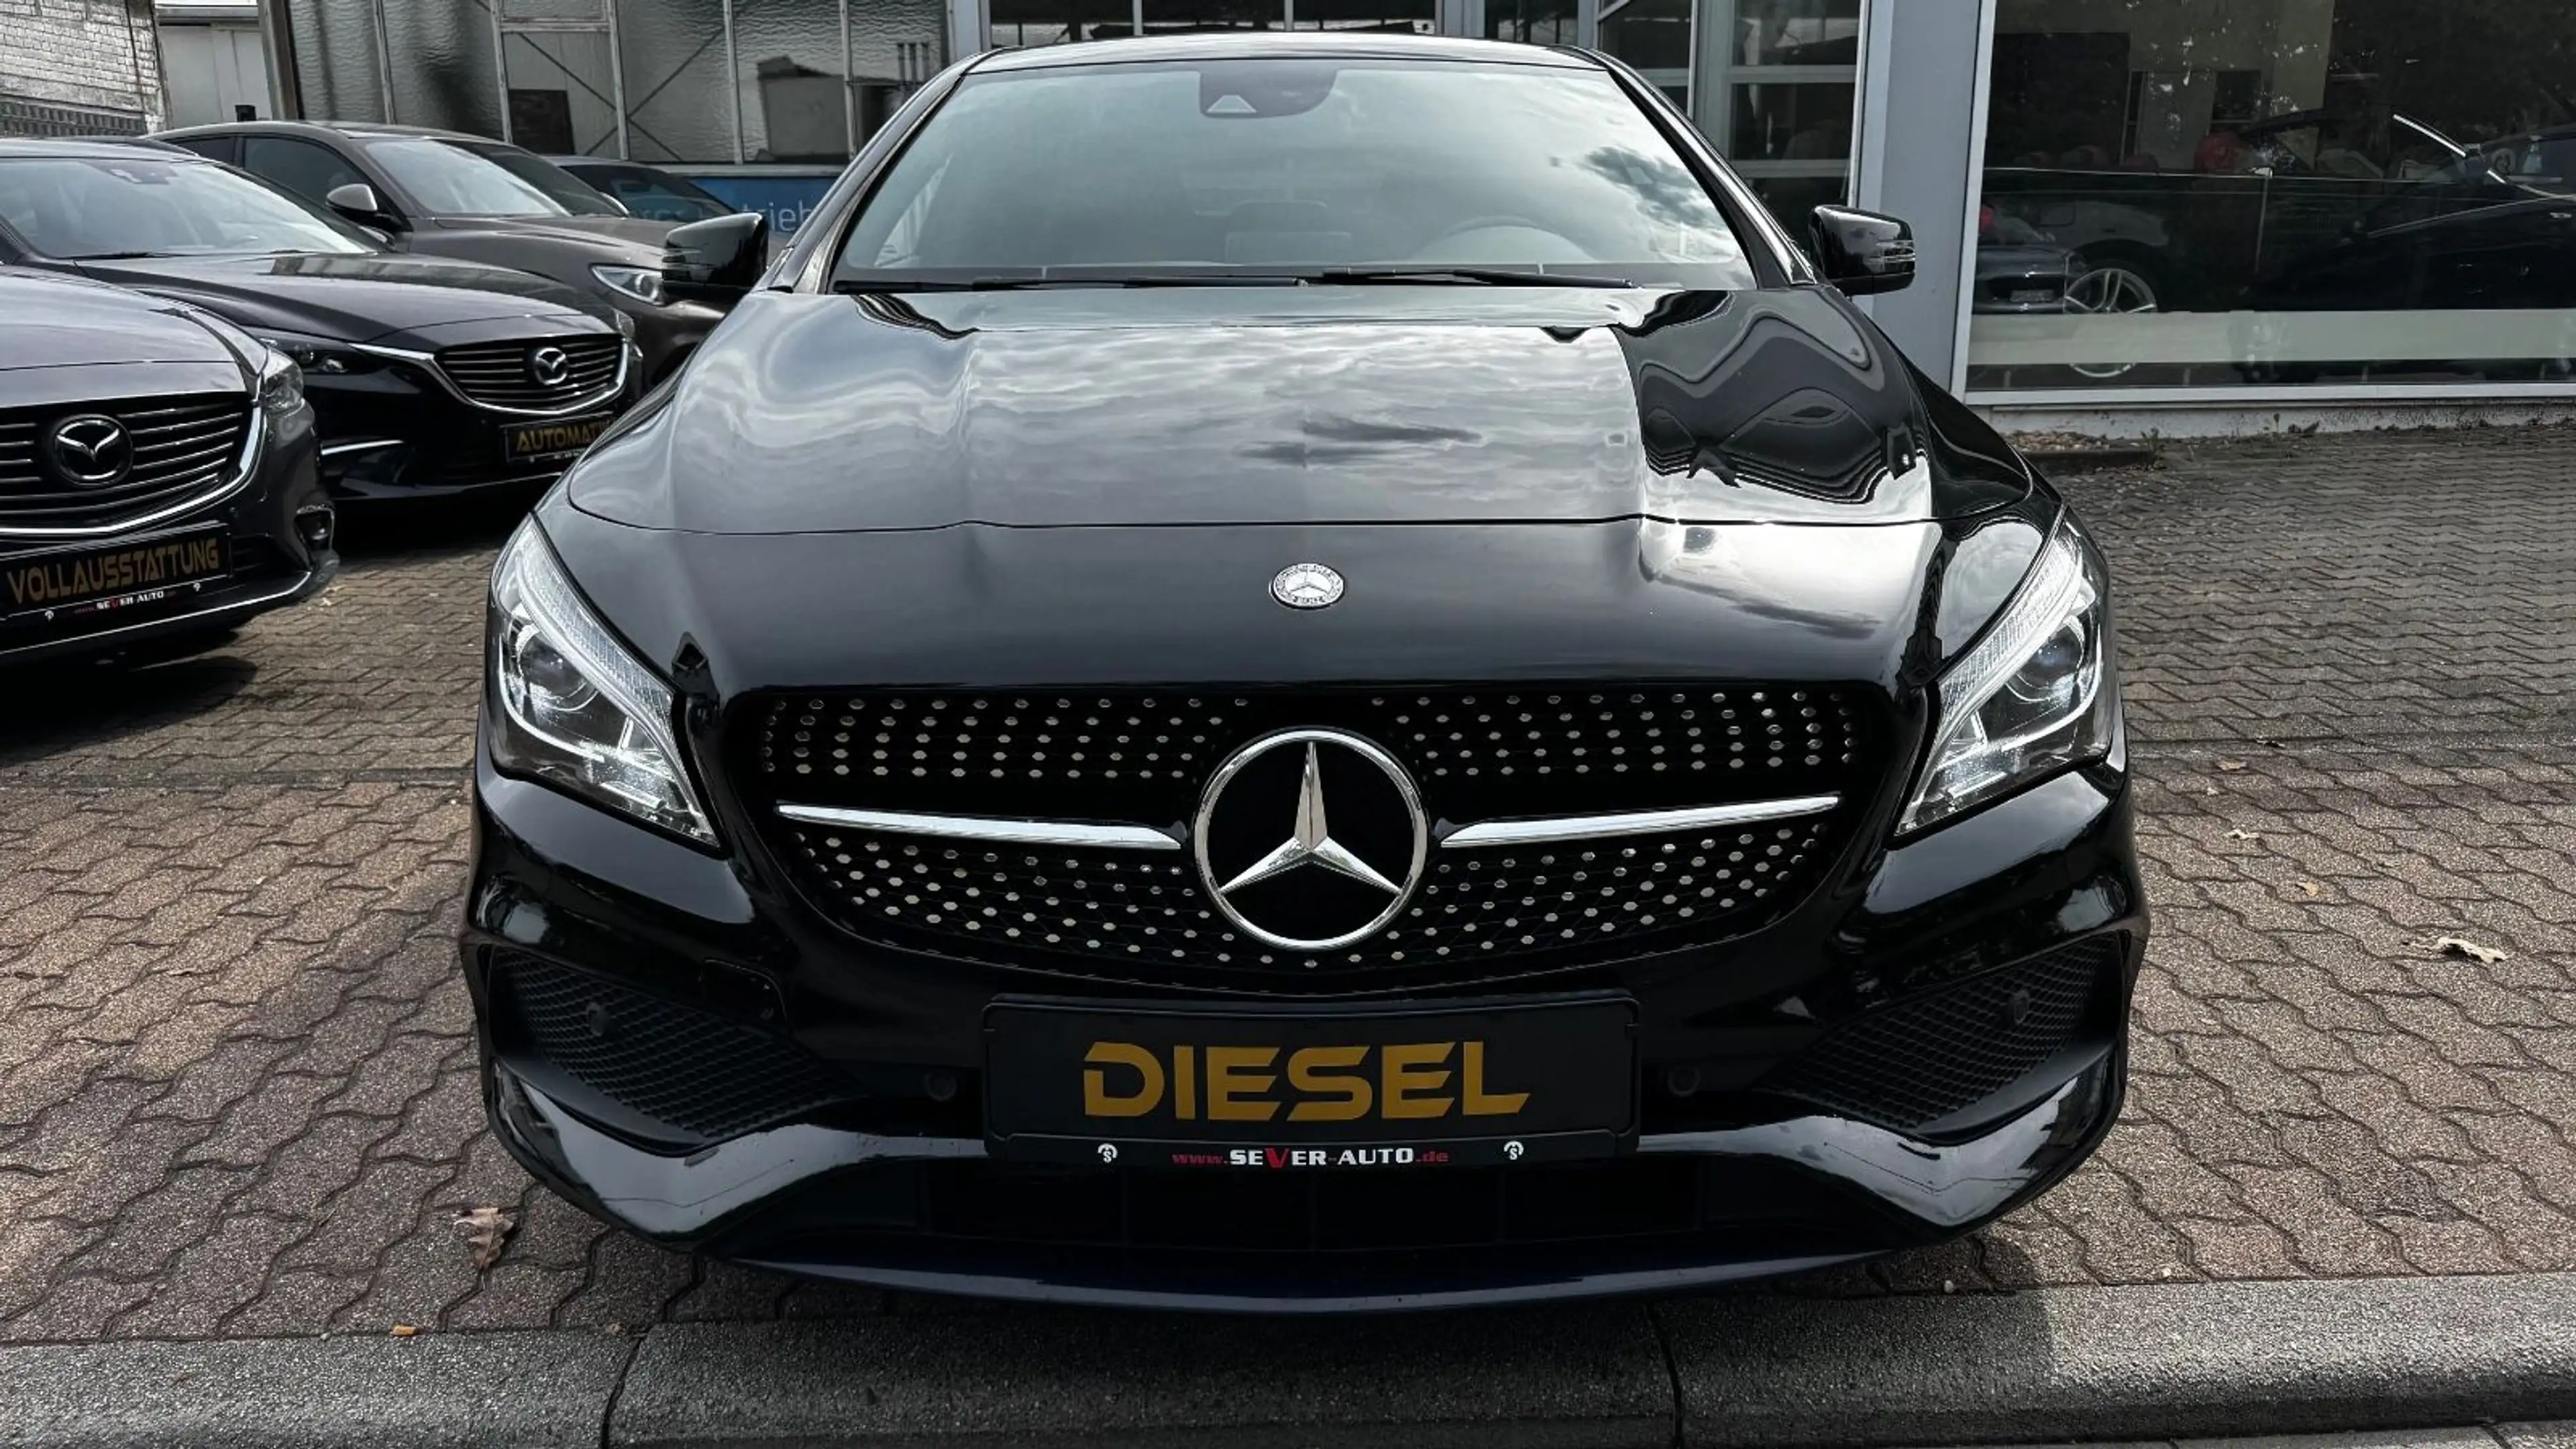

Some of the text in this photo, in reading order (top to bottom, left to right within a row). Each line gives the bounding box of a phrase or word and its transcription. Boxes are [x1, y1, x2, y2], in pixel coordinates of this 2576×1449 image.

[7, 539, 219, 604] VOLLAUSSTATTUNG
[1083, 1041, 1530, 1121] DIESEL
[1172, 1148, 1450, 1169] www.SEVER-AUTO.de
